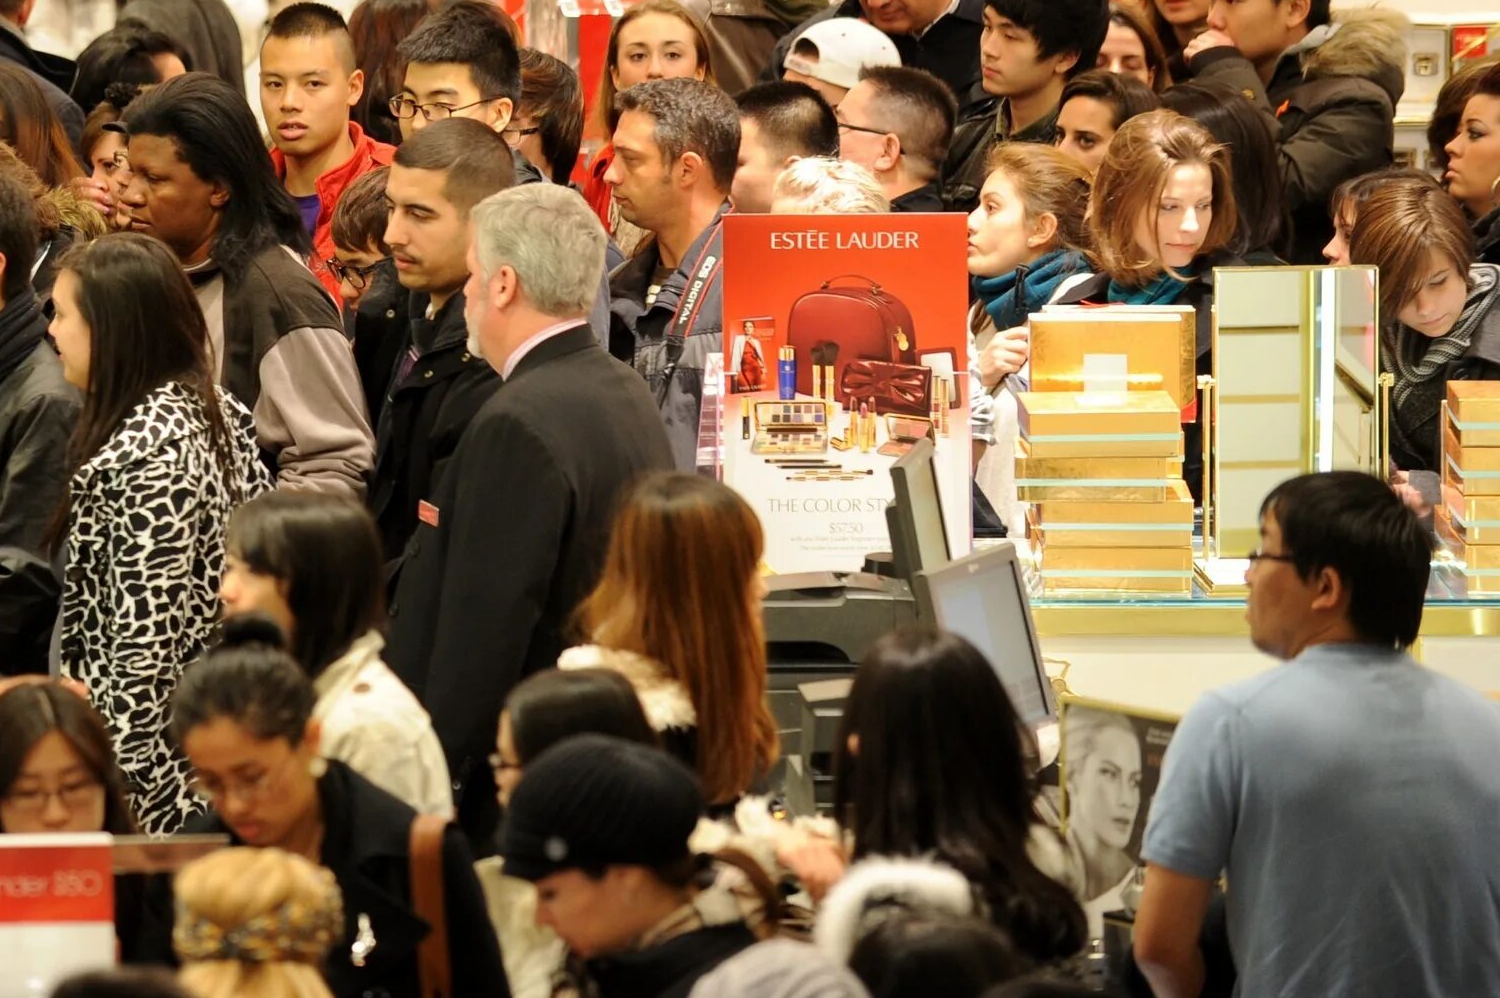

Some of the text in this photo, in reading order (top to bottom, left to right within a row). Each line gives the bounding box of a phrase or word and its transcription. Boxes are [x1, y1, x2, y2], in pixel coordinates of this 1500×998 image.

[836, 231, 920, 249] LAUDER
[679, 255, 716, 324] EOS DIGITAL
[767, 498, 799, 512] THE
[803, 497, 861, 512] COLOR
